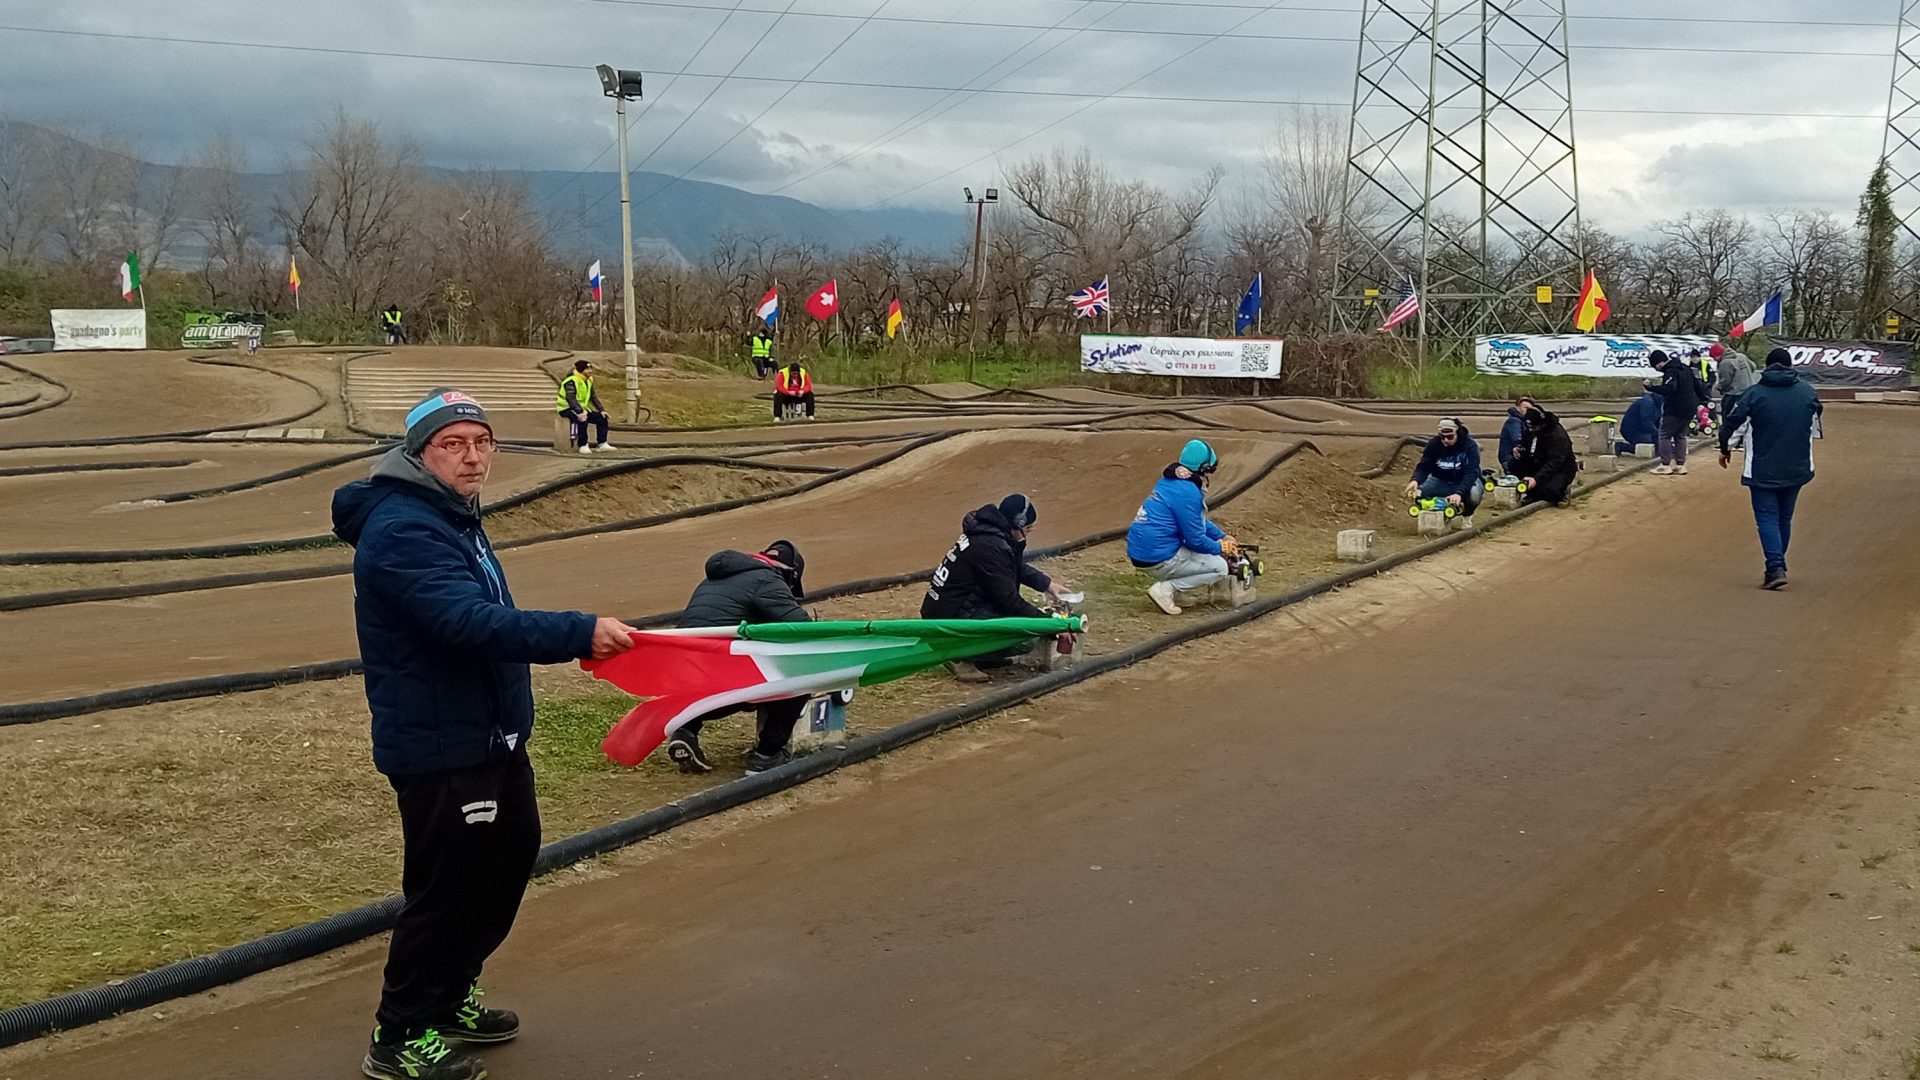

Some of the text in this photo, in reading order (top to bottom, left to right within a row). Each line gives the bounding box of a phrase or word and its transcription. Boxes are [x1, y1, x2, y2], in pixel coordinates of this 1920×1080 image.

[119, 325, 143, 338] party
[1182, 348, 1196, 358] per
[1488, 348, 1531, 358] NITRO
[1607, 348, 1651, 358] NITRO
[1820, 347, 1880, 368] RACE
[1486, 356, 1534, 367] PLAZA
[819, 701, 827, 720] 1
